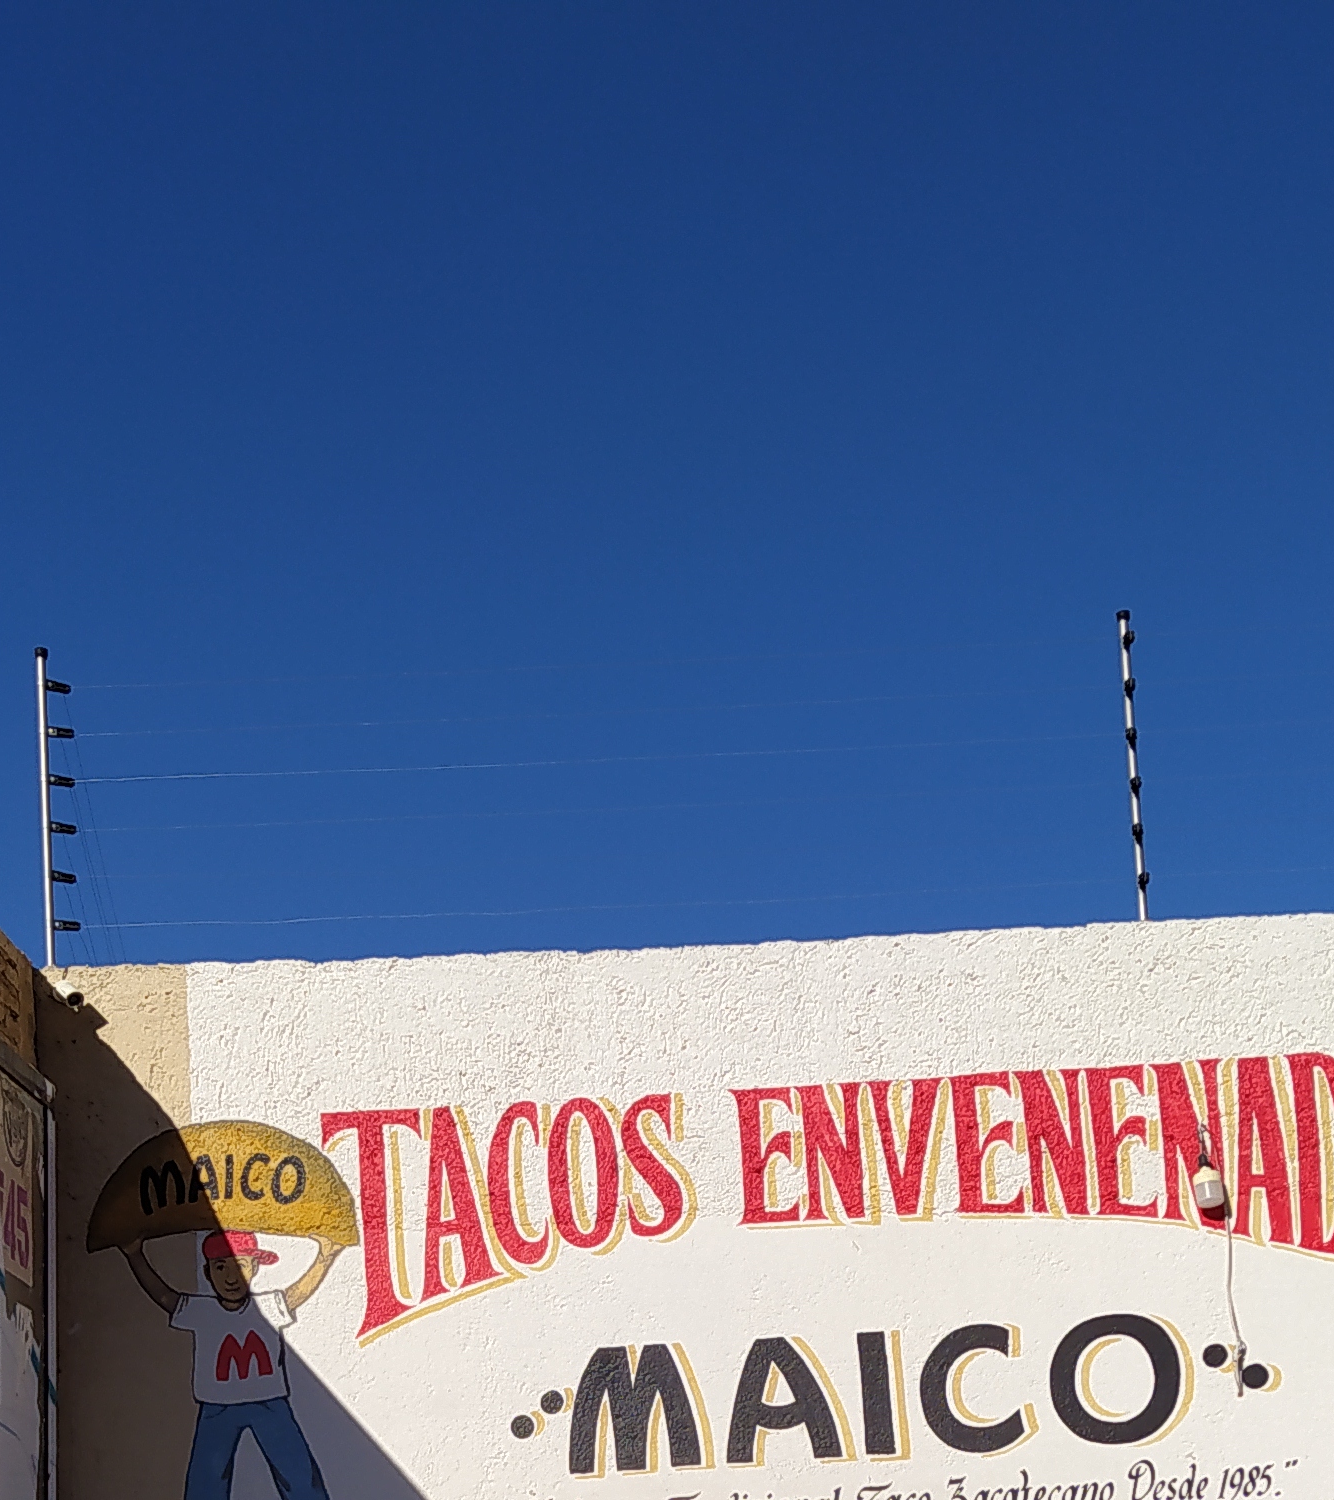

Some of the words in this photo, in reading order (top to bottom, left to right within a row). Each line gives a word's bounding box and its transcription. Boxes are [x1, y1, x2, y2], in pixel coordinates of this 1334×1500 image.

[139, 1152, 307, 1216] MAICO
[321, 1094, 689, 1342] TACOS
[569, 1312, 1187, 1478] MAICO
